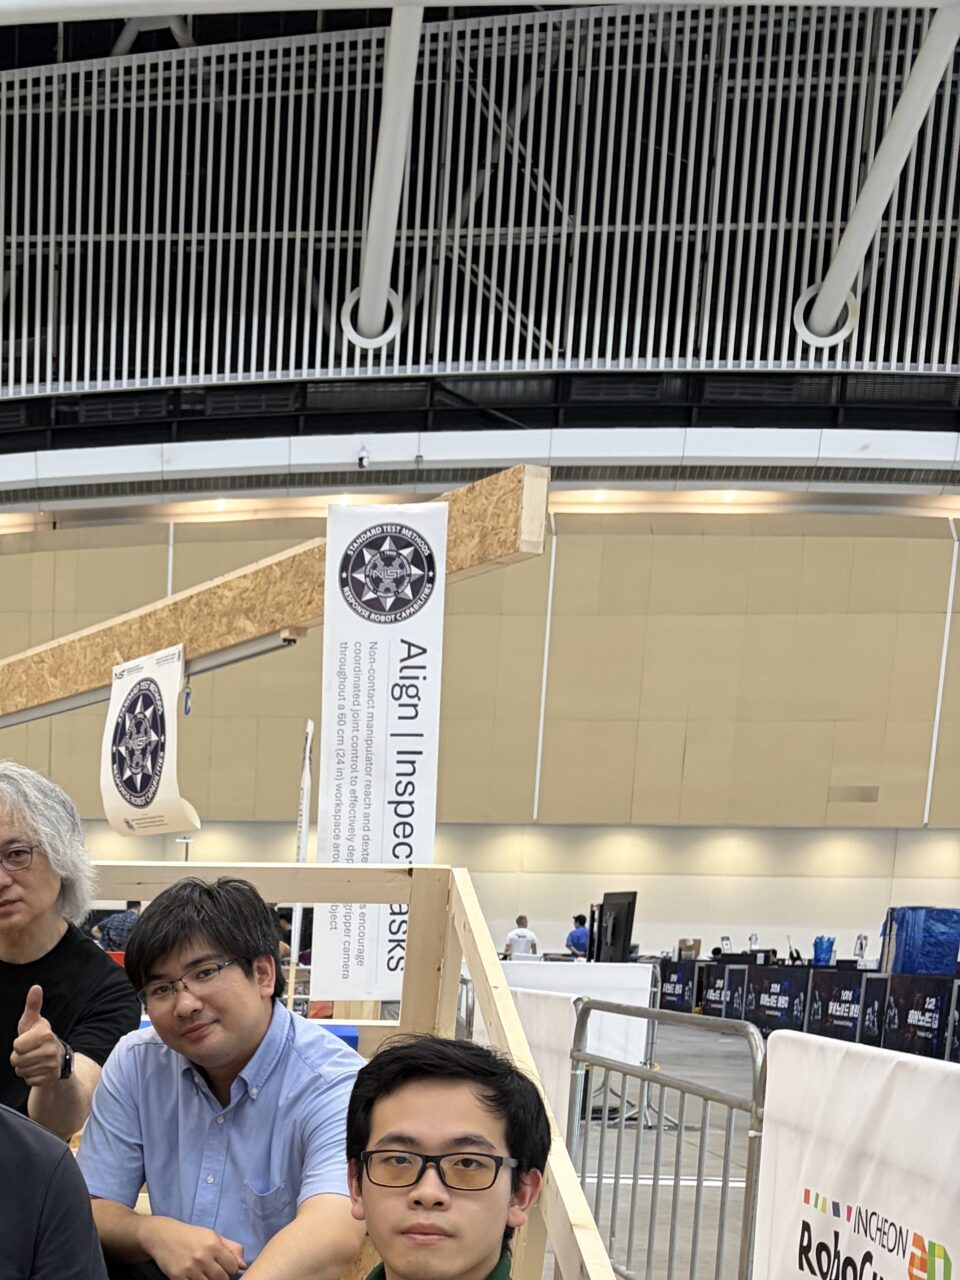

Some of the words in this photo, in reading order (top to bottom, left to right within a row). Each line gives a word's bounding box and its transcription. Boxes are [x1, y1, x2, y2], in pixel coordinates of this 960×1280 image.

[347, 526, 382, 555] STANDARD
[382, 525, 401, 533] TEST
[401, 527, 431, 556] METHODS
[372, 570, 402, 579] NIST
[343, 586, 371, 618] RESPONSE
[370, 613, 395, 622] ROBOT
[396, 583, 432, 618] CAPABILITIES
[337, 642, 348, 701] throughout
[352, 641, 362, 707] coordinated
[368, 641, 378, 710] Non-contact
[391, 638, 428, 721] Align
[336, 728, 345, 746] cm
[337, 712, 347, 727] 60
[349, 708, 360, 733] joint
[334, 748, 346, 765] (24
[349, 735, 359, 773] control
[363, 712, 375, 778] manipulator
[334, 767, 346, 782] in)
[349, 775, 358, 786] to
[332, 783, 343, 840] workspace
[363, 779, 373, 810] reach
[387, 750, 424, 865] Inspec
[346, 788, 358, 842] effectively
[362, 812, 372, 832] and
[360, 834, 371, 863] dexte
[328, 904, 340, 930] bject
[355, 911, 367, 967] encourage
[386, 904, 410, 972] asks
[342, 940, 352, 979] camera
[853, 1205, 909, 1259] INCHEON
